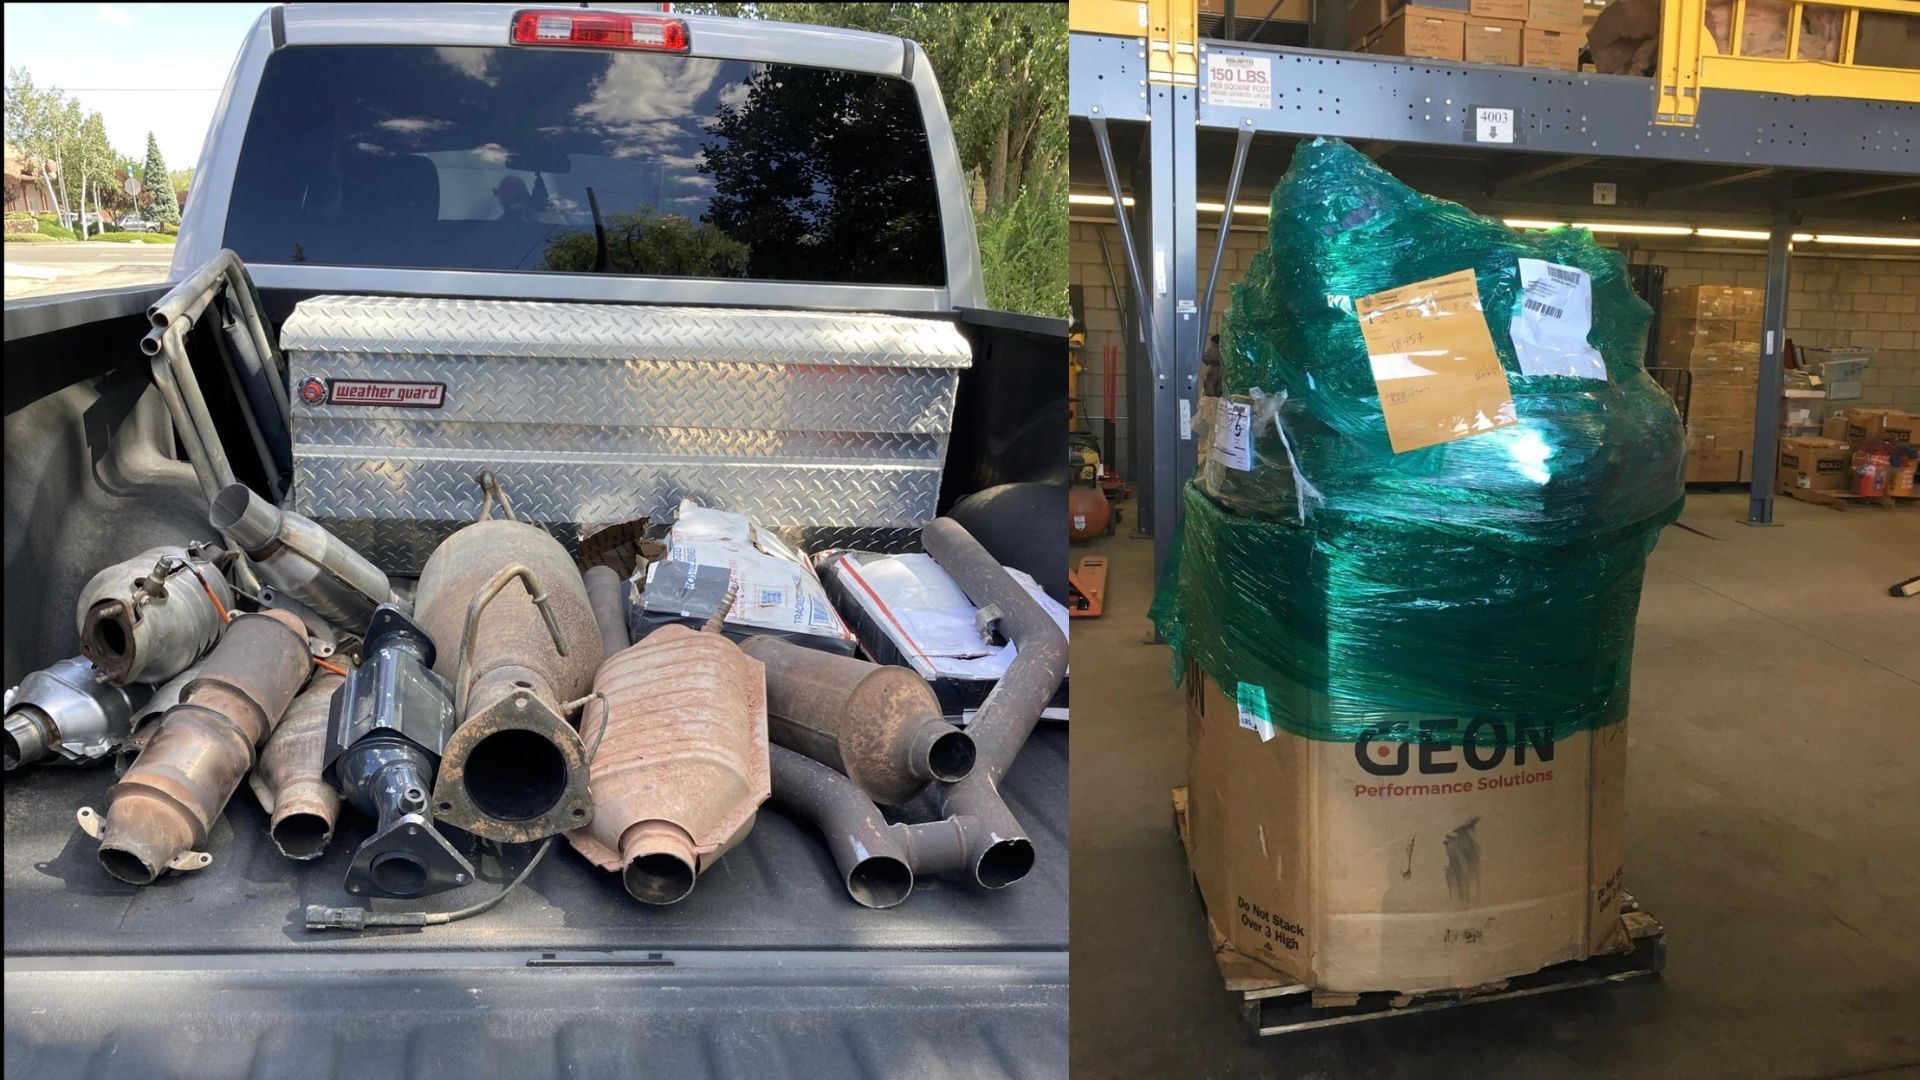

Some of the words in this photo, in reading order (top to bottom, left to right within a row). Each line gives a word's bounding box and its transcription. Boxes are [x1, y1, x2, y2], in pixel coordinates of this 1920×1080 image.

[1210, 68, 1233, 81] 150
[1237, 69, 1269, 84] LBS.
[1224, 83, 1250, 92] SQUARE
[1252, 85, 1270, 93] FOOT
[1480, 111, 1509, 124] 4003
[336, 384, 395, 398] weather
[397, 386, 438, 401] guard
[1355, 715, 1555, 776] GEON
[1354, 780, 1473, 798] Performance
[1478, 770, 1554, 791] Solutions
[1238, 896, 1250, 911] Do
[1253, 904, 1270, 922] Not
[1272, 914, 1305, 936] Stack
[1241, 913, 1262, 932] Over
[1265, 926, 1272, 938] 3
[1275, 930, 1299, 950] High
